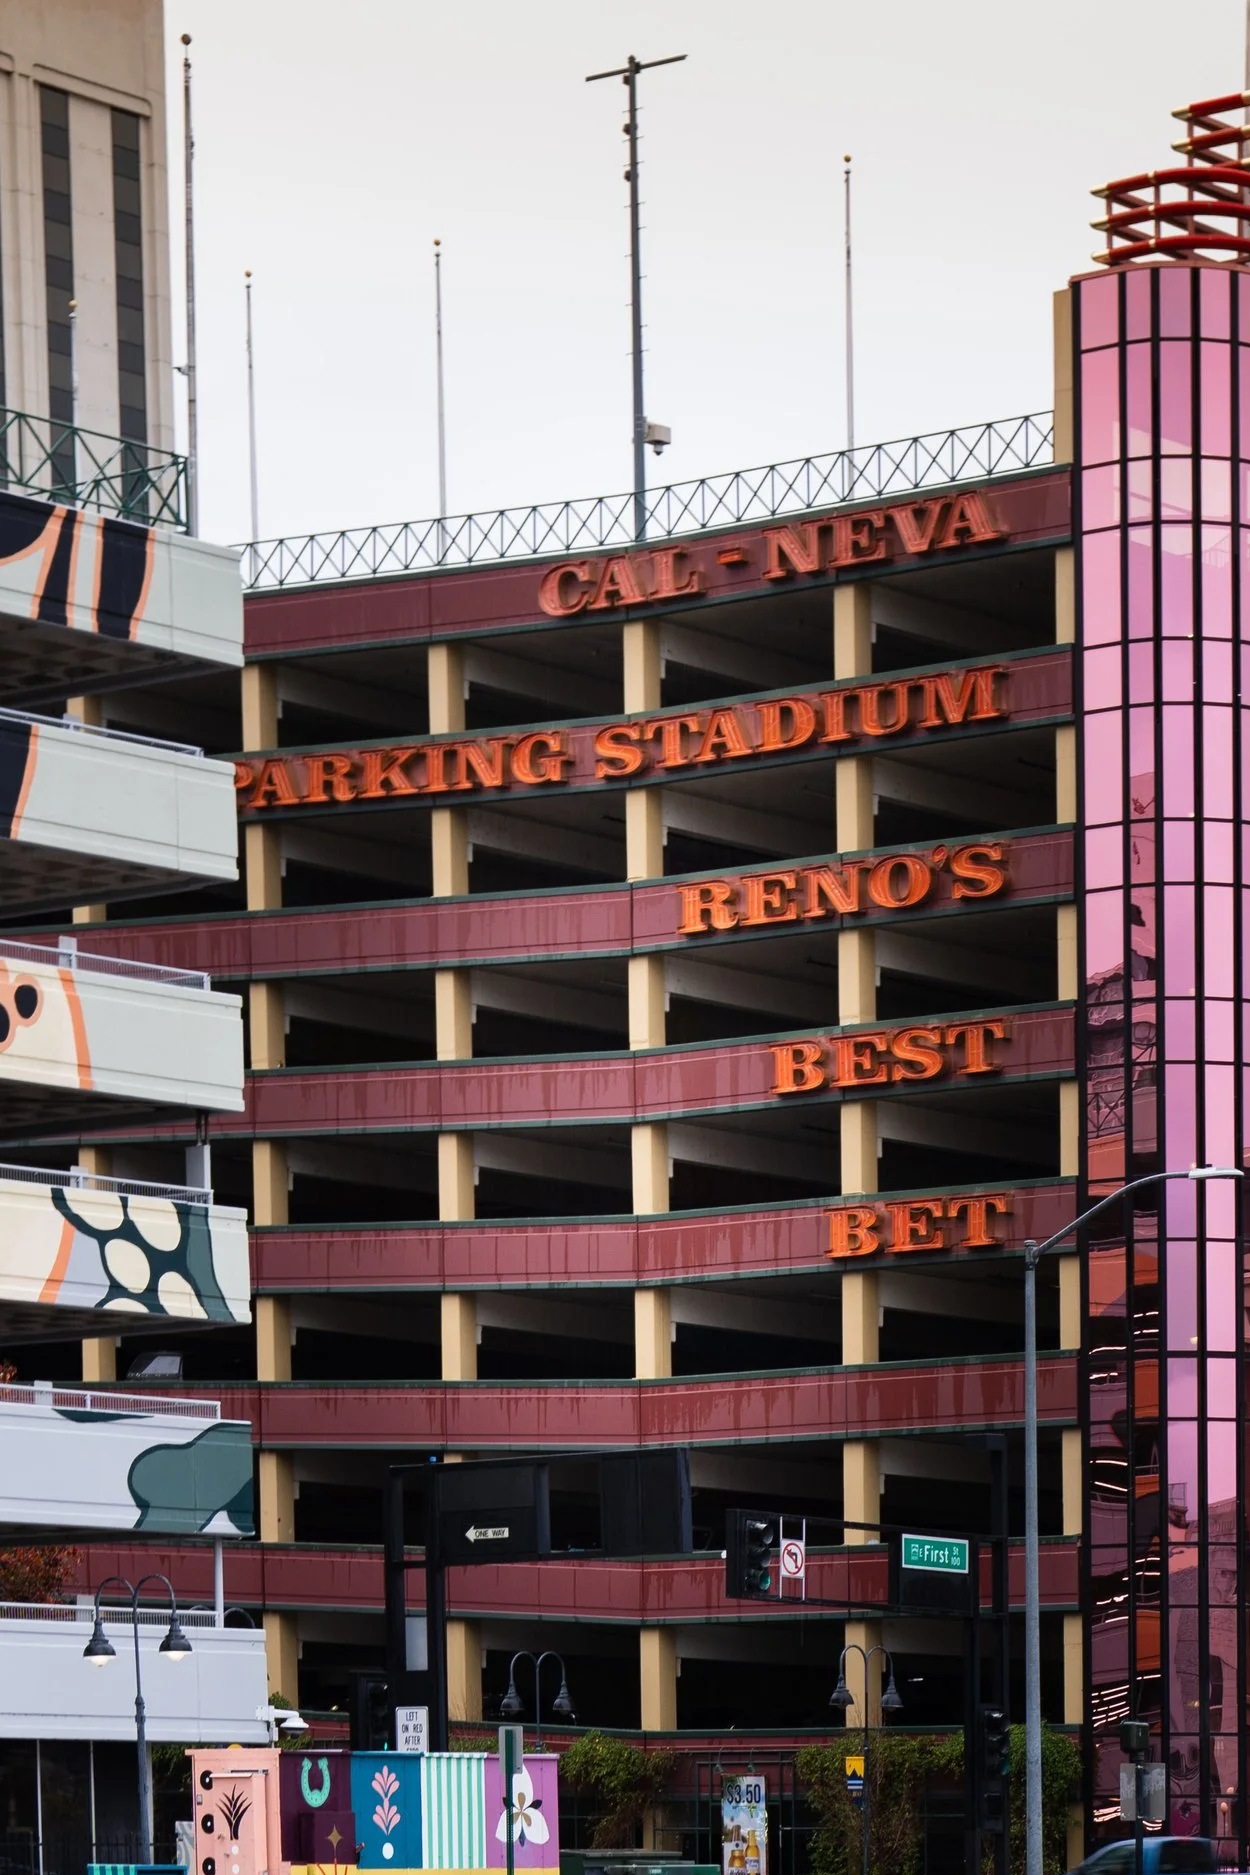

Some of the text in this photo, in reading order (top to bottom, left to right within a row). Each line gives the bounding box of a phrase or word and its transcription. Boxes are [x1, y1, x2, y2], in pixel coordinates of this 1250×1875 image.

[595, 663, 1010, 781] STADIUM
[677, 839, 1009, 938] RENO'S
[769, 1017, 1010, 1096] BEST
[824, 1192, 1013, 1260] BET
[475, 1529, 506, 1538] ONE WAY
[924, 1544, 949, 1564] First
[952, 1546, 959, 1556] St
[951, 1556, 961, 1566] 100
[405, 1711, 418, 1721] LEFT
[401, 1723, 424, 1734] ON RED
[404, 1735, 421, 1746] AFTER
[726, 1783, 761, 1805] $3.50
